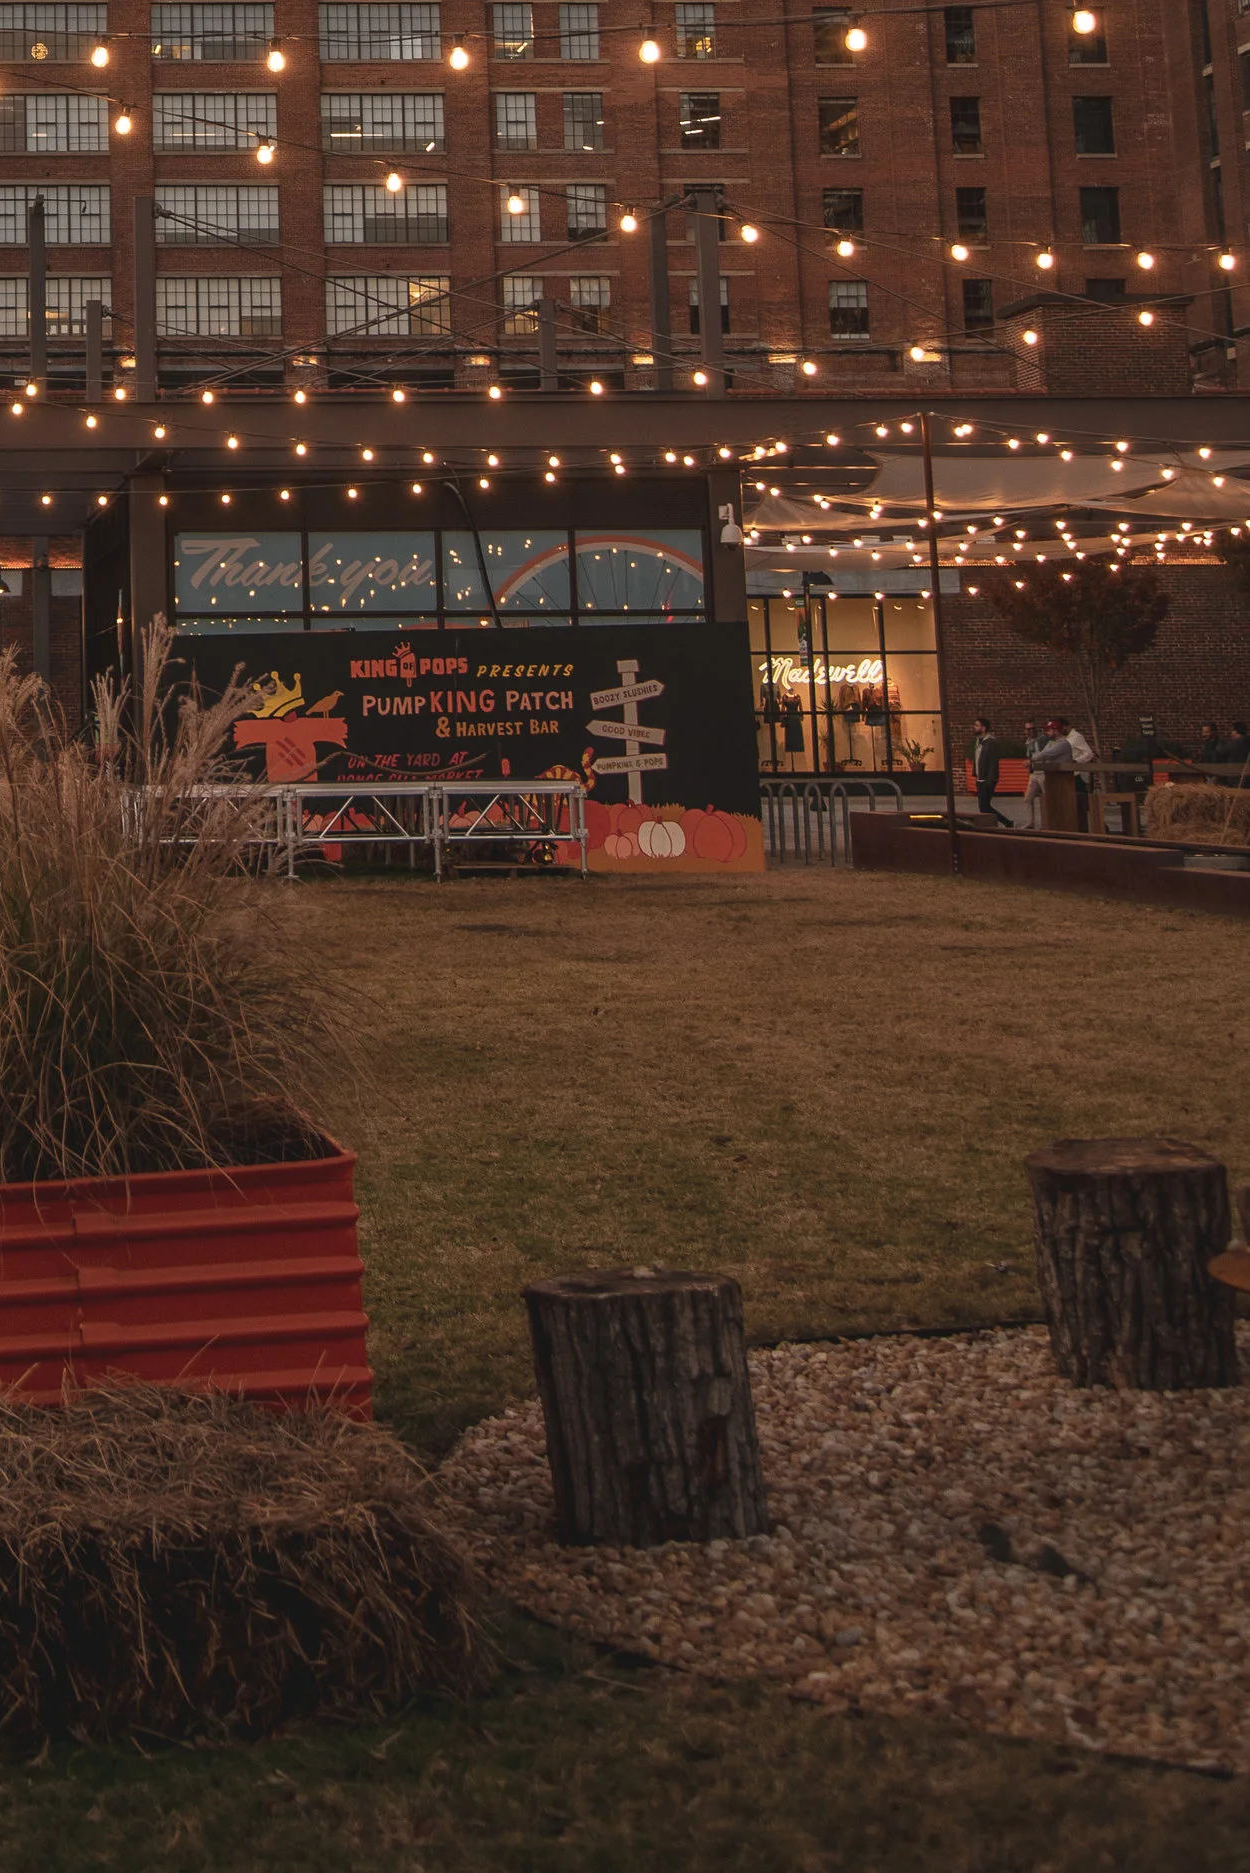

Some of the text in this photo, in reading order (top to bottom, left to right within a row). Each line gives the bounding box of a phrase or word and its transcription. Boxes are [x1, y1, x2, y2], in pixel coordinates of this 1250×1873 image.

[181, 537, 435, 604] Thank you
[350, 657, 575, 679] KING OF POPS PRESENTS
[758, 657, 885, 690] Madewell
[505, 690, 574, 712] PATCH
[593, 684, 659, 705] BOOZY SLUSHIES
[435, 716, 560, 738] & HARVEST BAR
[601, 725, 652, 739] GOOD VIBES
[374, 753, 402, 768] THE
[406, 753, 441, 767] YARD
[449, 751, 469, 765] AT
[644, 757, 664, 767] POPS
